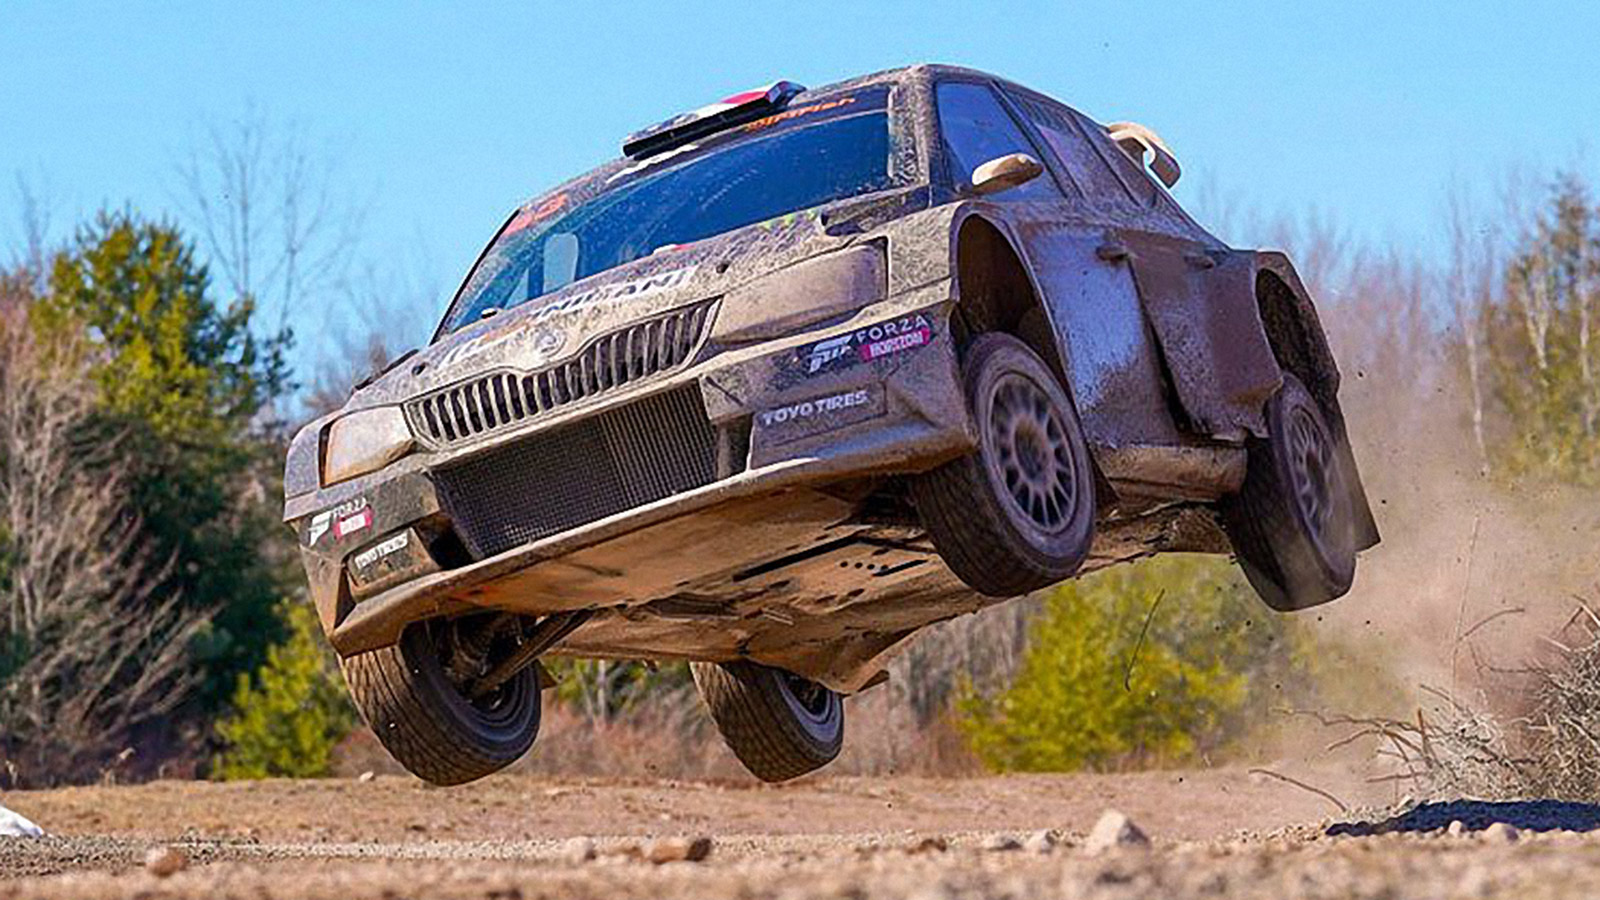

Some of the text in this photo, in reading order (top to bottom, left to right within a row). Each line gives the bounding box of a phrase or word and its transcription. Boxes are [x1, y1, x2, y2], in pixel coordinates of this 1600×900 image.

[856, 315, 929, 343] FORZA
[762, 390, 869, 425] TOYO TIRES
